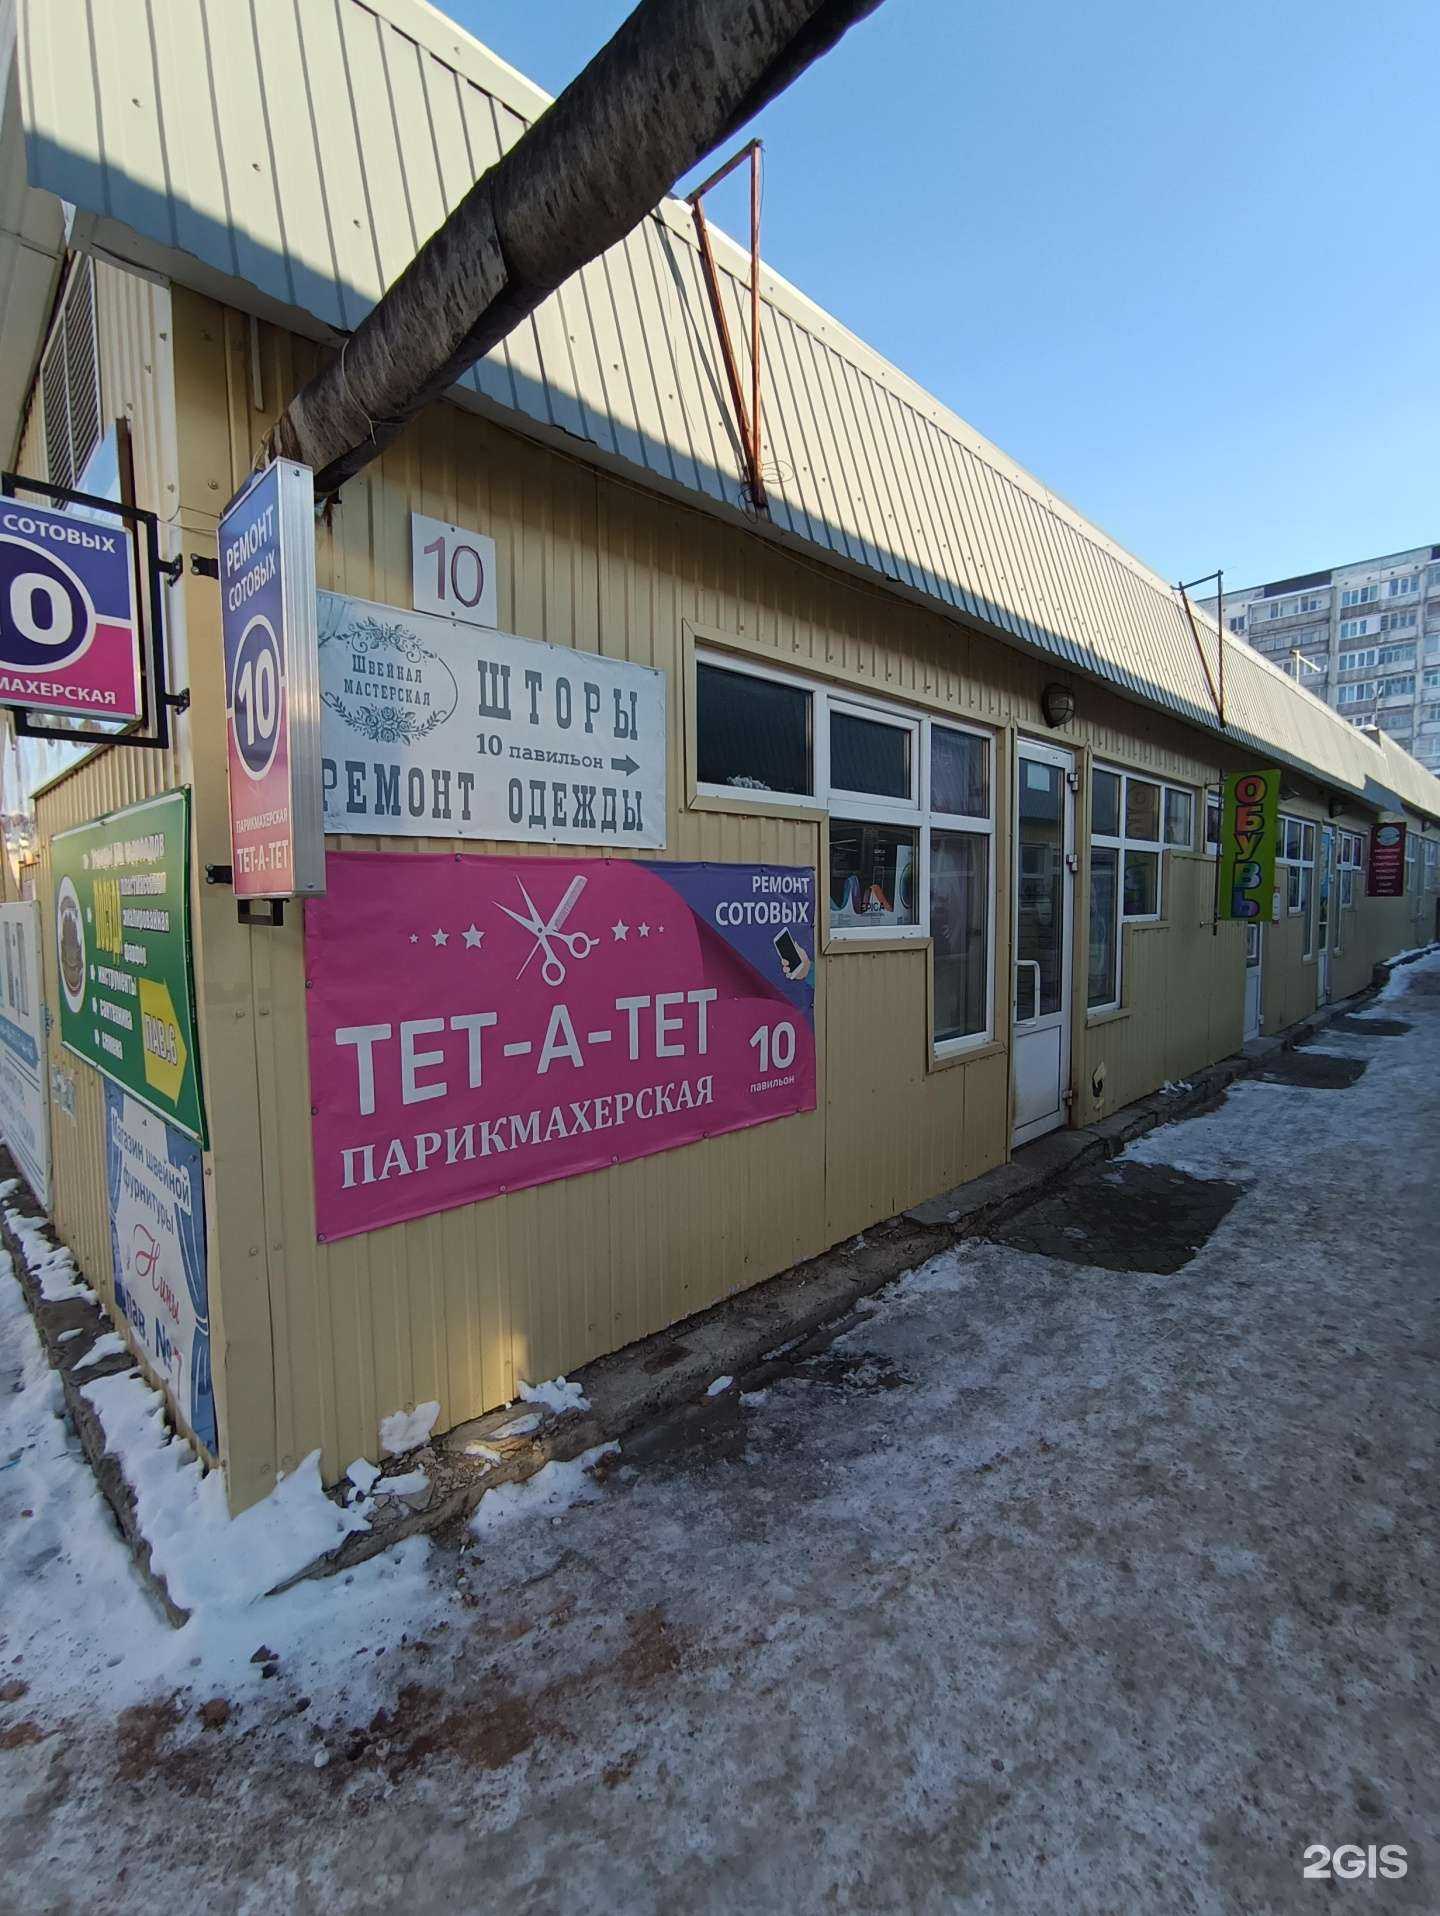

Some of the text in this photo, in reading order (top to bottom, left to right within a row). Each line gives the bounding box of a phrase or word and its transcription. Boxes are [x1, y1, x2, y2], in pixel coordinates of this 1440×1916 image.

[3, 514, 116, 554] СОТОВЫХ
[226, 504, 275, 578] РЕМОНТ
[228, 549, 277, 612] СОТОВЫХ
[423, 535, 485, 609] 10
[0, 572, 73, 645] 0
[237, 647, 276, 746] 10
[343, 678, 431, 706] МАСТЕРСКАЯ
[351, 653, 423, 684] ШВЕЙНАЯ
[477, 659, 639, 741] ШТОРЫ
[476, 732, 604, 769] 10 павильон
[235, 808, 289, 837] ПАРИКМАХЕРСКАЯ
[320, 757, 644, 833] РЕМОНТ ОДЕЖДЫ
[237, 839, 290, 874] ТЕТ-А-ТЕТ
[1231, 775, 1267, 917] ОБУВЬ
[714, 900, 810, 927] СОТОВЫХ
[751, 874, 810, 895] РЕМОНТ
[335, 987, 718, 1116] ТЕТ-А-ТЕТ
[749, 1020, 797, 1072] 10
[749, 1075, 796, 1094] павильон
[340, 1075, 714, 1189] ПАРИКМАХЕРСКАЯ
[123, 1160, 174, 1236] фурнитуры
